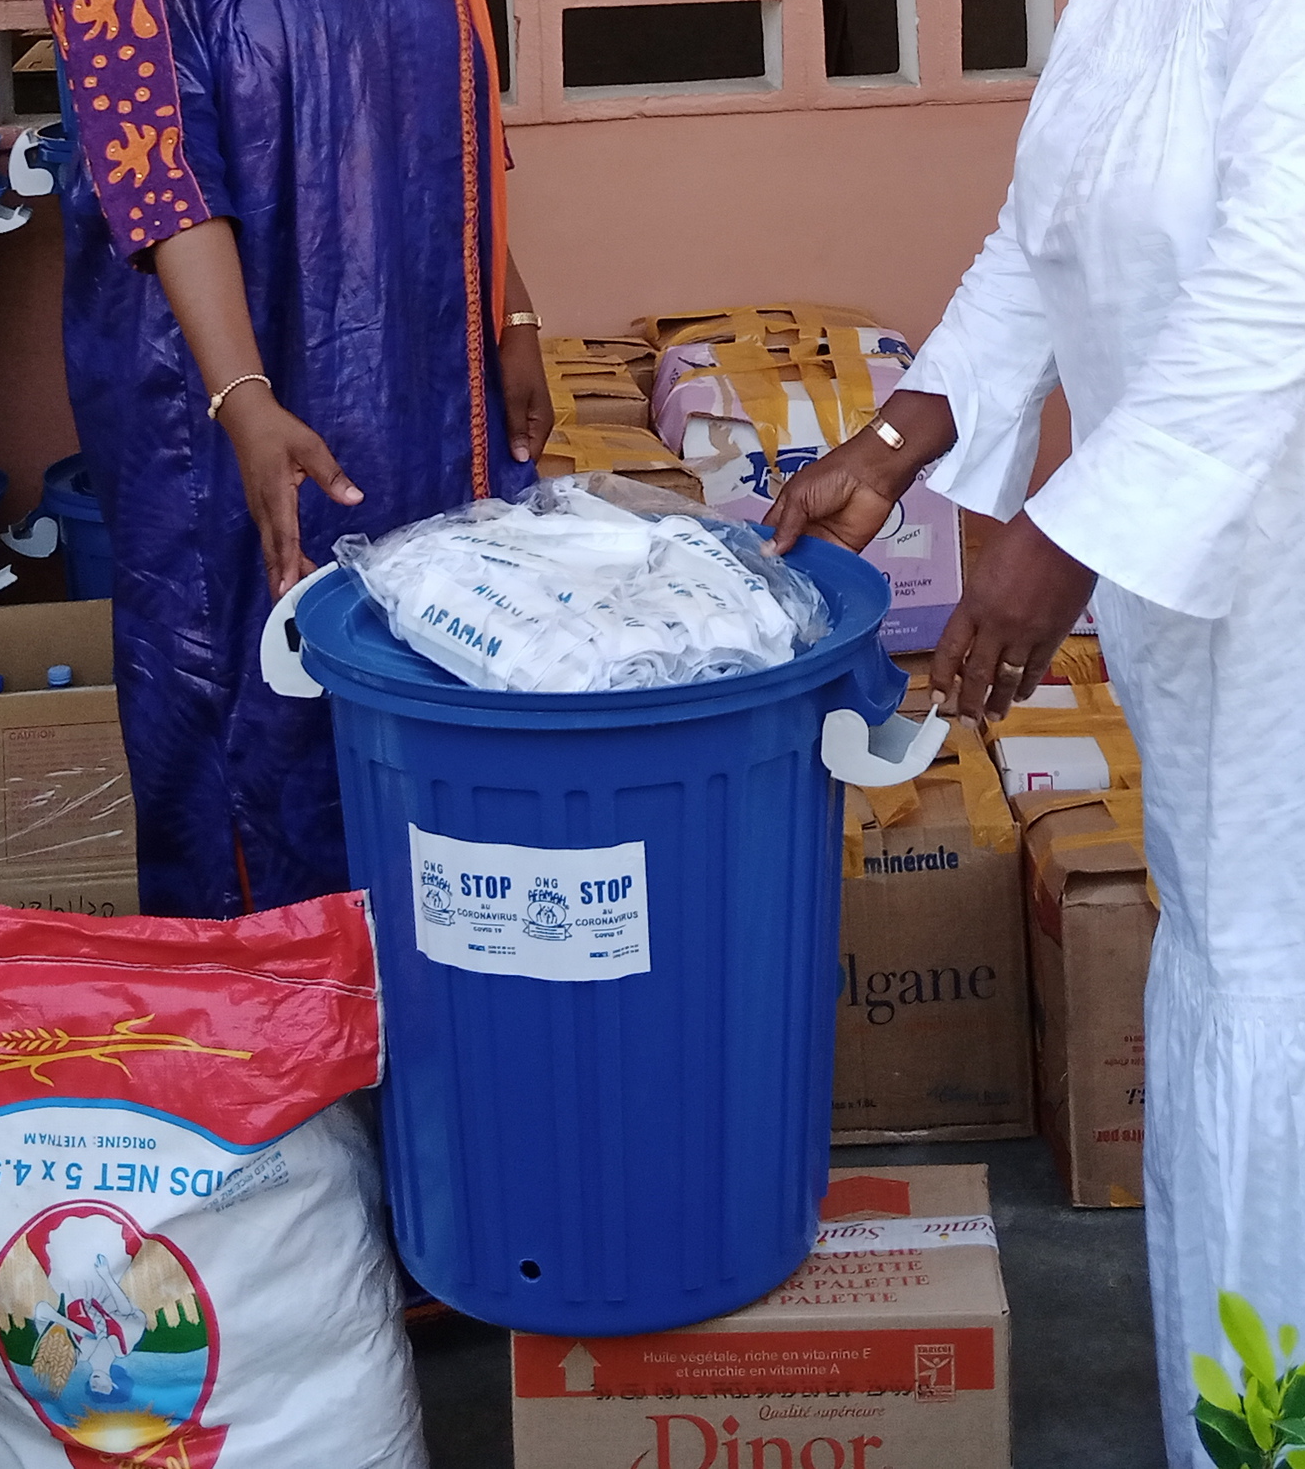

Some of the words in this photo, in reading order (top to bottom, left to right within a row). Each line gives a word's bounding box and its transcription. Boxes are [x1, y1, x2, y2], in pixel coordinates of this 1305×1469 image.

[896, 528, 921, 545] POCKET
[894, 579, 932, 589] SANITARY
[894, 588, 916, 597] PADS
[9, 730, 56, 741] CAUTION
[424, 860, 443, 874] ONG
[864, 846, 959, 874] minérale
[460, 873, 512, 899] STOP
[535, 876, 559, 889] ONG
[580, 875, 632, 905] STOP
[457, 908, 518, 922] CORONAVIRUS
[575, 911, 639, 927] CORONAVIRUS
[842, 953, 997, 1026] lgane
[23, 1133, 87, 1149] VIETNAM
[92, 1136, 156, 1150] ORIGINE:
[41, 1160, 56, 1181] x
[65, 1162, 83, 1190] 5
[94, 1162, 159, 1193] NET
[169, 1165, 236, 1197] IDS
[816, 1224, 885, 1247] Sani
[807, 1260, 923, 1275] PALETTE
[814, 1274, 930, 1290] PALETTE
[781, 1292, 898, 1305] PALETTE
[644, 1350, 677, 1364] Huile
[680, 1349, 742, 1365] végétale,
[745, 1349, 778, 1362] riche
[782, 1351, 799, 1361] en
[802, 1348, 859, 1361] vitamine
[676, 1366, 691, 1378] et
[694, 1364, 745, 1377] enrichie
[749, 1366, 767, 1376] en
[770, 1363, 826, 1376] vitamine
[830, 1364, 840, 1375] A
[759, 1404, 810, 1421] Qualité
[814, 1405, 886, 1420] supérieure
[645, 1414, 883, 1469] Dinor
